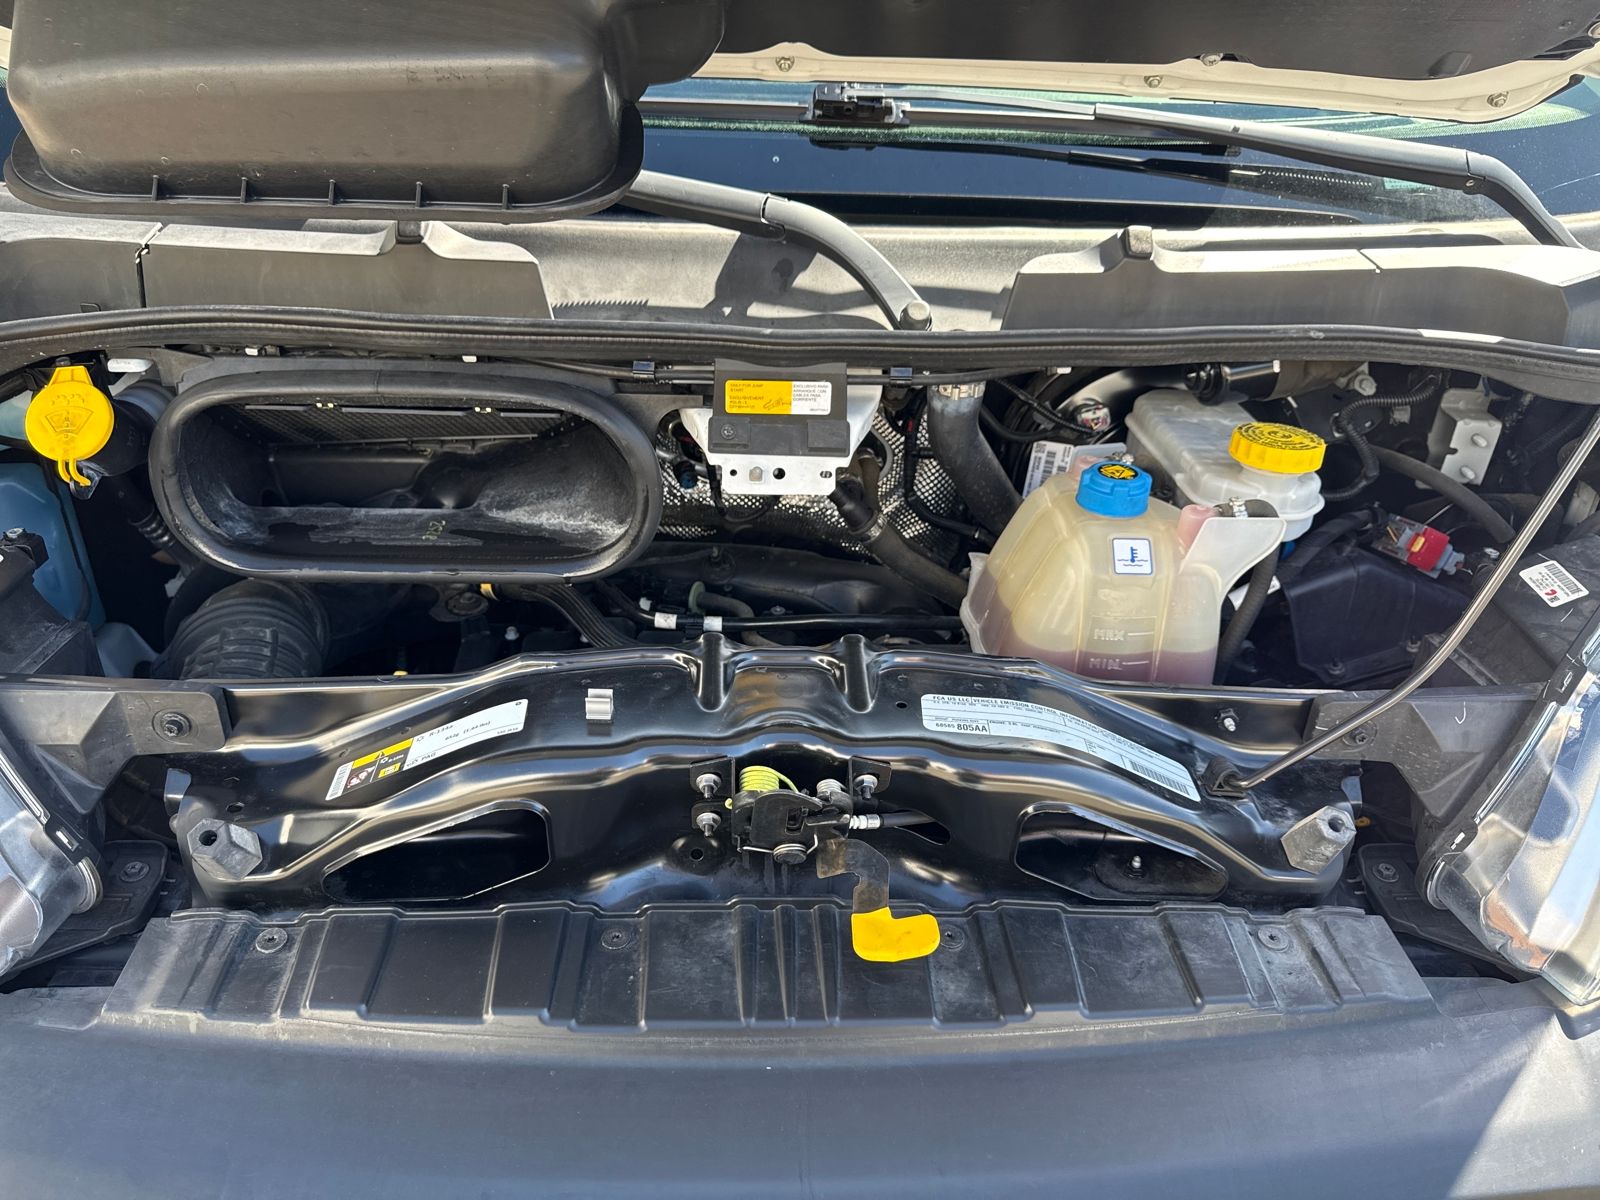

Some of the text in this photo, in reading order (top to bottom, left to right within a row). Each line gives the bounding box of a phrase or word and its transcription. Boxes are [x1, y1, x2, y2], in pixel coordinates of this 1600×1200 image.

[1093, 629, 1125, 641] MAX
[1000, 700, 1029, 708] EMISSION
[1031, 704, 1057, 714] CONTROL
[956, 723, 988, 732] 805AA
